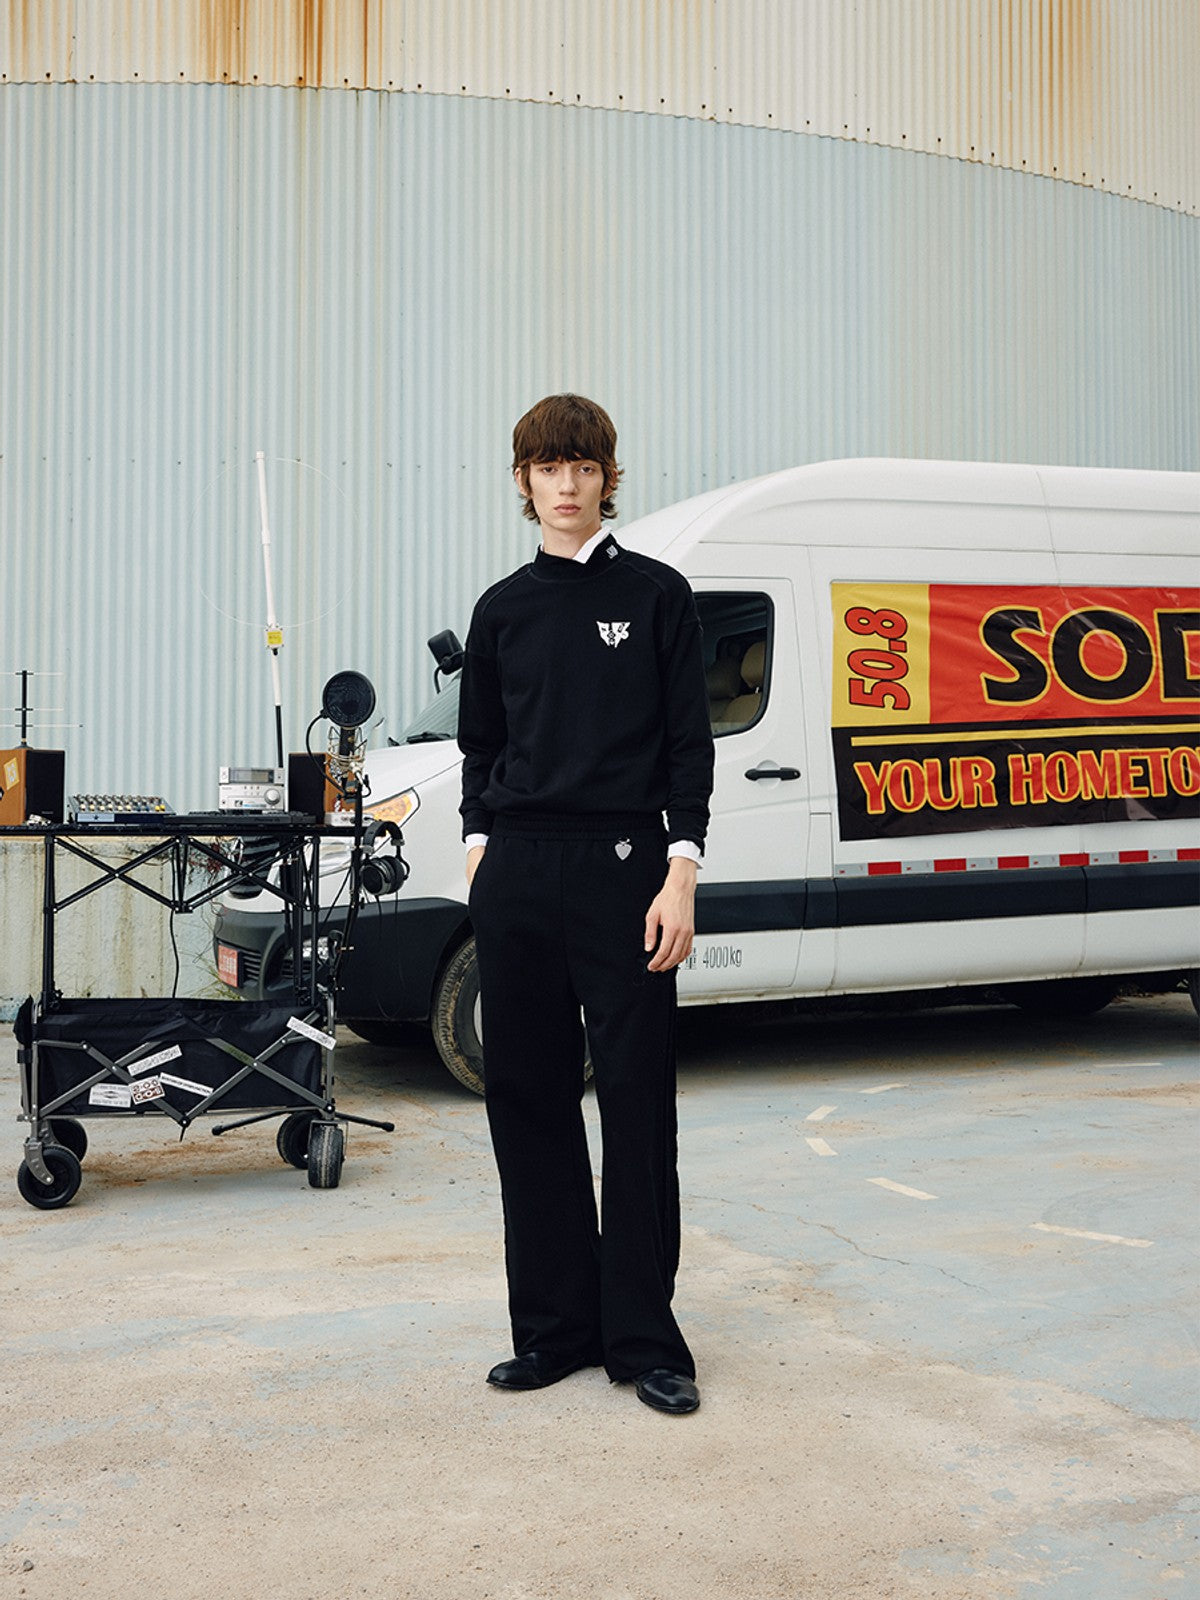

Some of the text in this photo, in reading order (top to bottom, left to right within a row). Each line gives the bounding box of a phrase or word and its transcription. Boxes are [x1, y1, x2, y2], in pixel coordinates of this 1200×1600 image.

[844, 606, 911, 711] 50.8
[853, 755, 999, 815] YOUR
[702, 946, 743, 969] 4000kg
